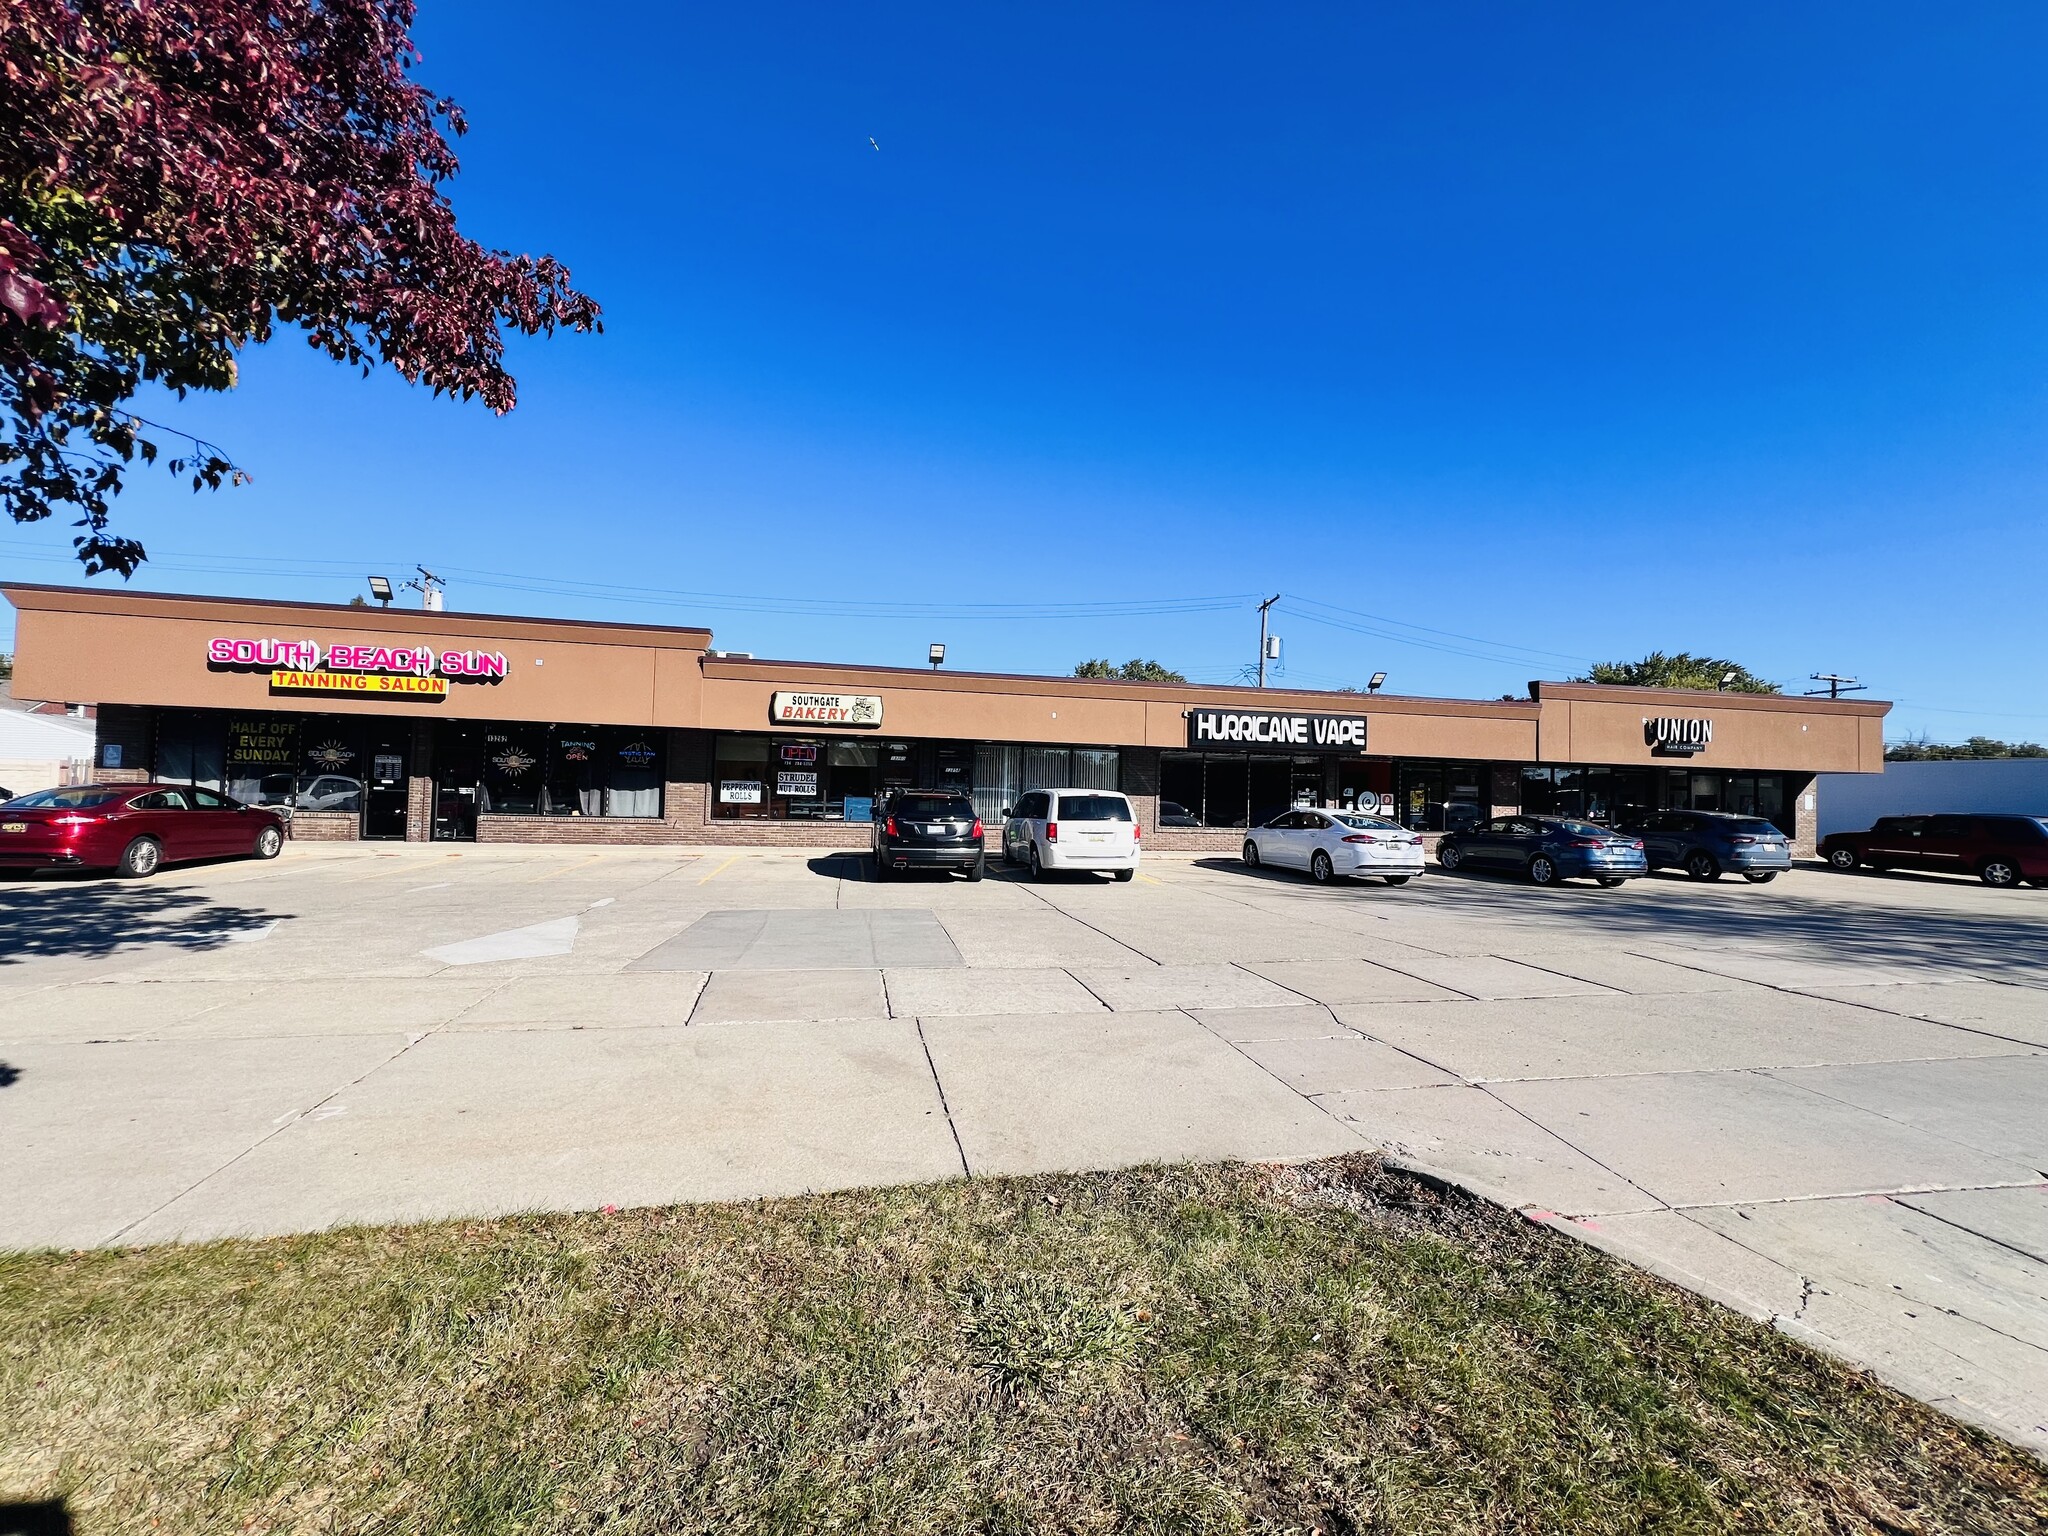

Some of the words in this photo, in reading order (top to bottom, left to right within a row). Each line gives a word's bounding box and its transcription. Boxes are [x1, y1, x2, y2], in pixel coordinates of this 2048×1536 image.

[208, 638, 320, 671] SOUTH
[322, 644, 435, 676] BEACH
[440, 650, 508, 677] SUN
[276, 672, 367, 688] TANNING
[380, 677, 444, 692] SALON
[792, 695, 840, 706] SOUTHGATE
[782, 706, 849, 720] BAKERY
[230, 722, 266, 733] HALF
[270, 723, 296, 734] OFF
[1197, 713, 1308, 743] HURRICANE
[1313, 718, 1365, 745] VAPE
[1657, 717, 1713, 742] UNION
[240, 735, 285, 747] EVERY
[560, 740, 596, 751] TANNING
[233, 748, 290, 761] SUNDAY
[565, 752, 589, 761] OPEN
[778, 772, 816, 783] STRUDEL
[722, 782, 760, 792] PEPPERONI
[778, 784, 793, 793] NUT
[794, 785, 816, 794] ROLLS
[729, 791, 753, 801] ROLLS
